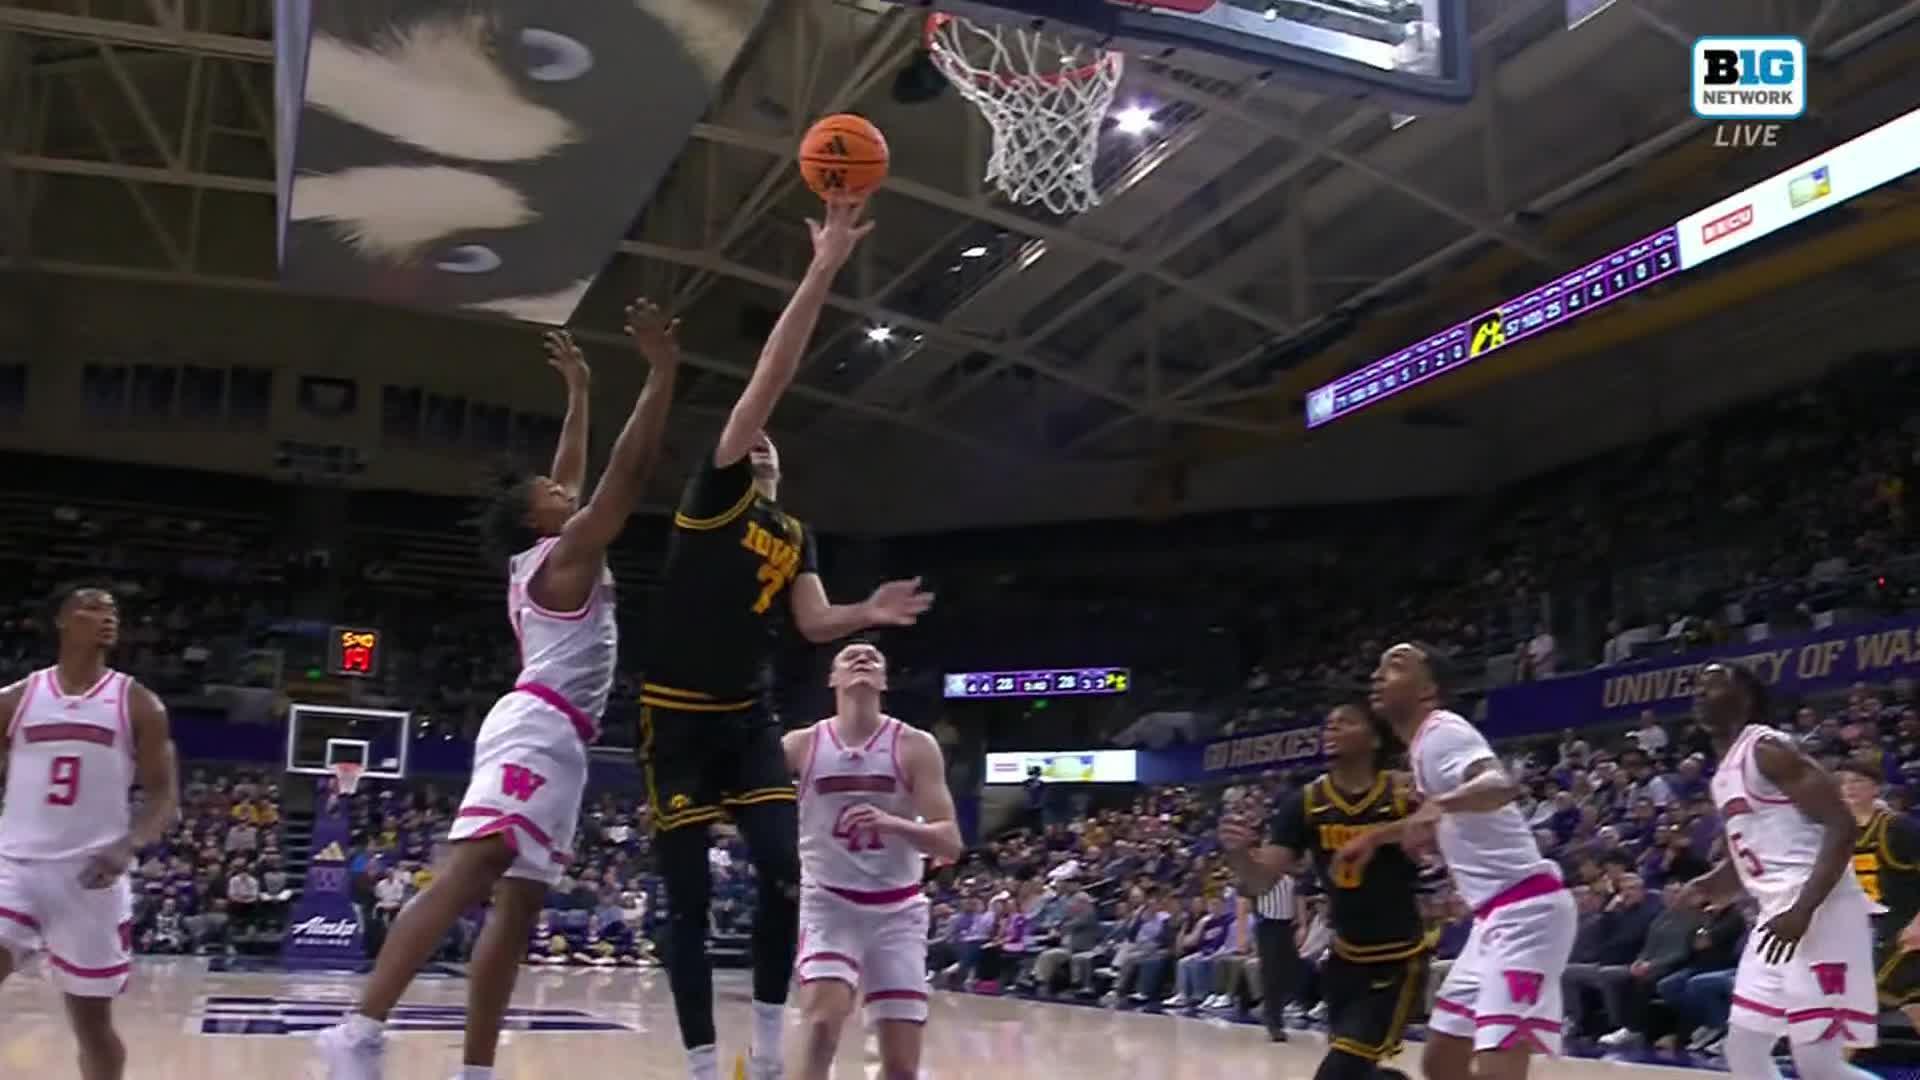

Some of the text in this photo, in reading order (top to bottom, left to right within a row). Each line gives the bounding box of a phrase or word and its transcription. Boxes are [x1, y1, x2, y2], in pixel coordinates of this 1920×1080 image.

[1591, 284, 1603, 298] 4
[1613, 274, 1624, 288] 1
[1659, 252, 1672, 269] 3
[752, 563, 785, 615] 7
[1798, 639, 1846, 680] OF
[48, 756, 81, 806] 9
[502, 763, 547, 802] W
[1503, 969, 1544, 1005] W
